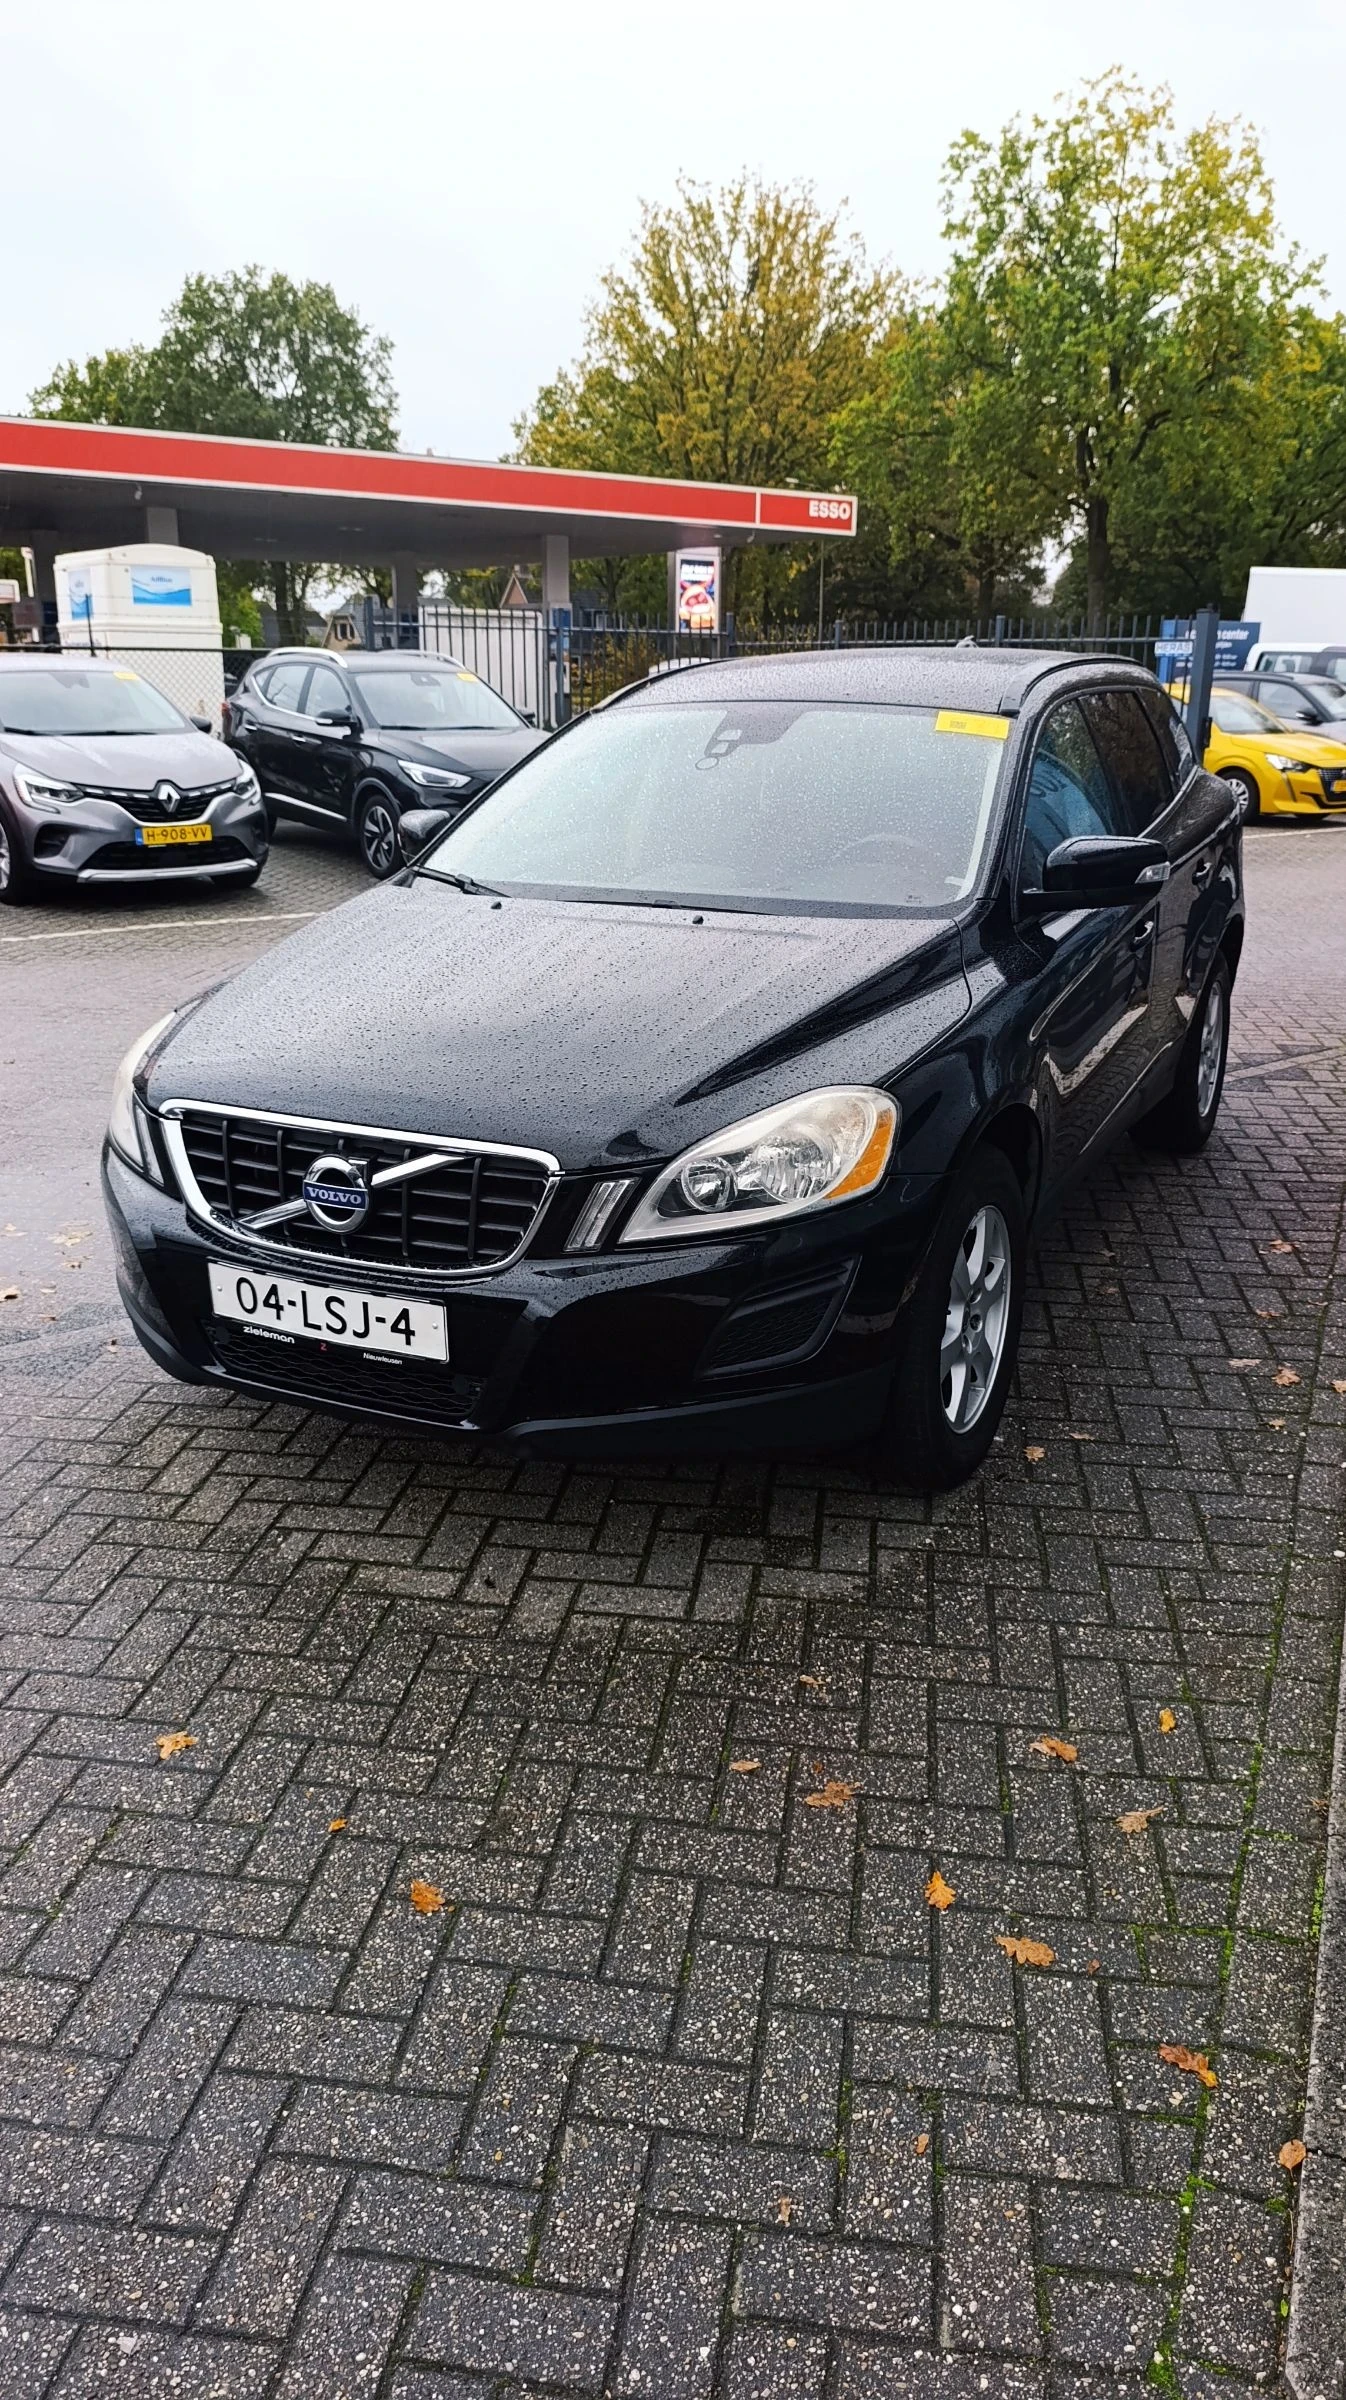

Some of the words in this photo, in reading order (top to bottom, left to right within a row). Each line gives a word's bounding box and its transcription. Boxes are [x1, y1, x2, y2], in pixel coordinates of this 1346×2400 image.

[808, 499, 852, 520] ESSO
[1156, 641, 1191, 653] HERAS
[146, 826, 208, 842] H-908-VV
[306, 1186, 362, 1205] VOLVO
[236, 1276, 416, 1346] 04-LSJ-4
[242, 1325, 296, 1345] zieleman
[362, 1351, 403, 1366] Nieuwleusen
